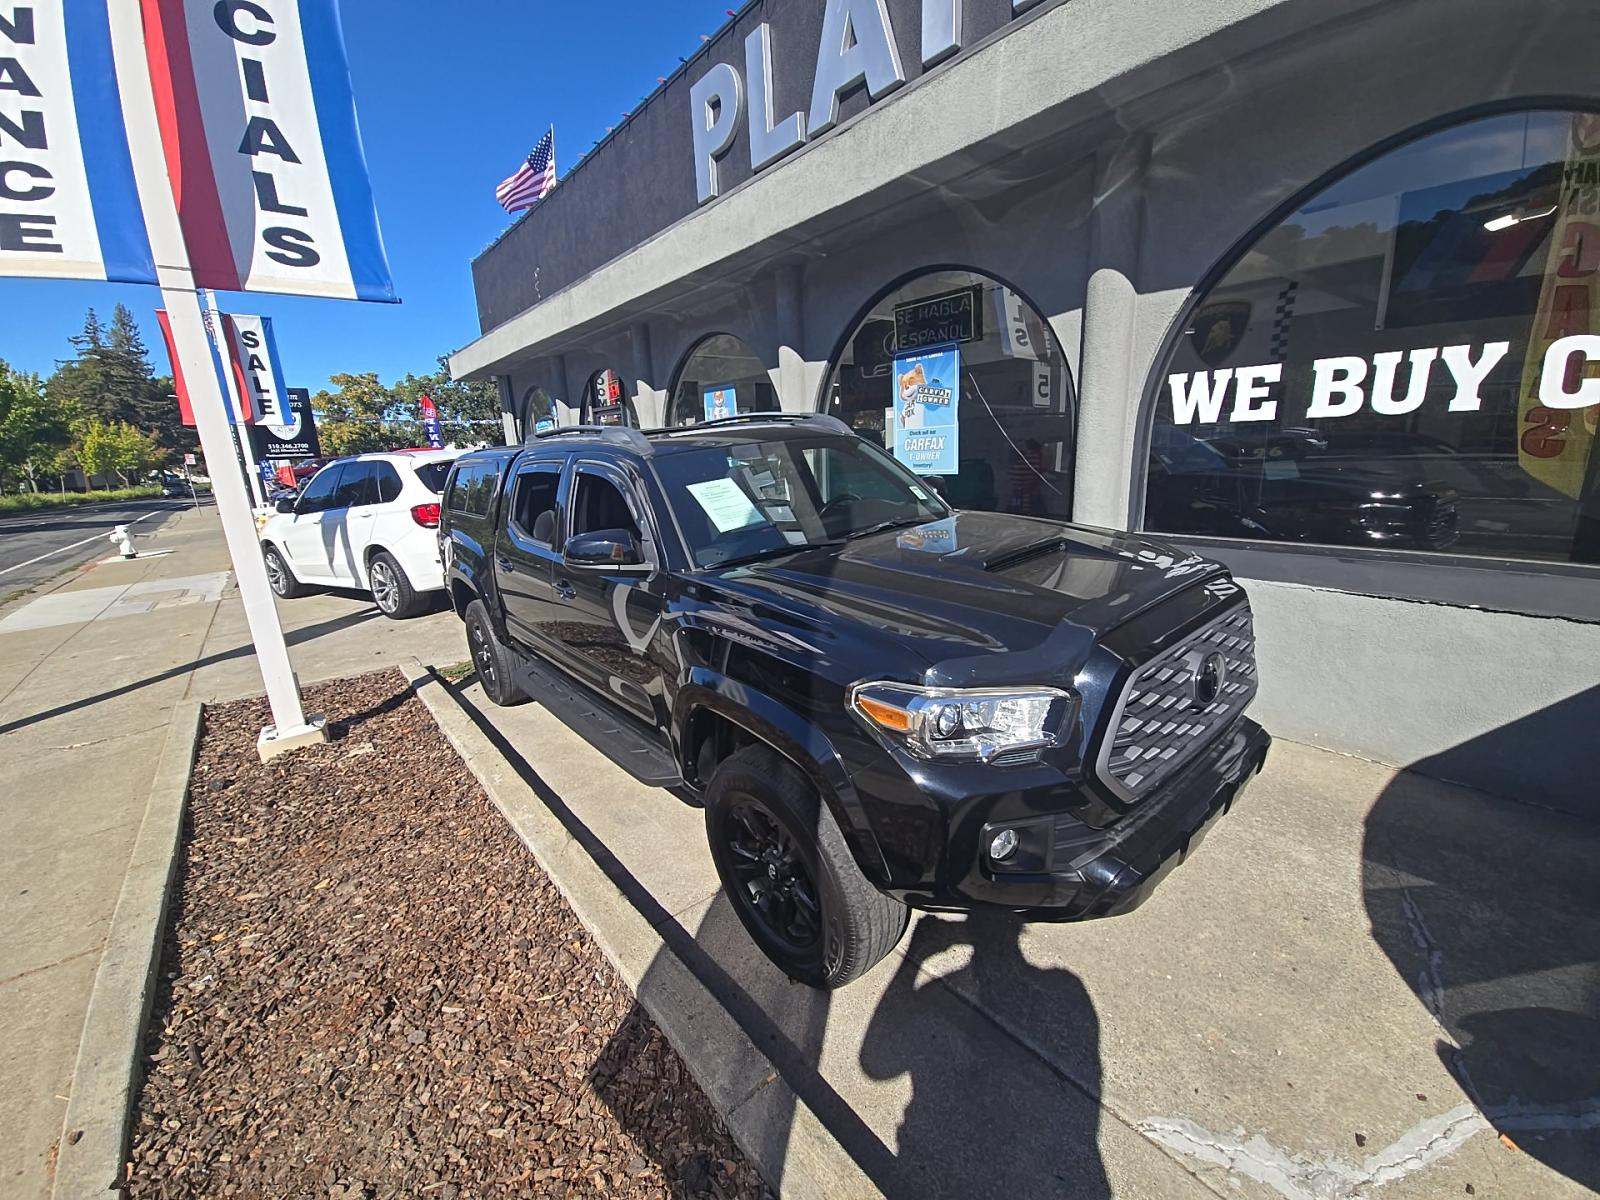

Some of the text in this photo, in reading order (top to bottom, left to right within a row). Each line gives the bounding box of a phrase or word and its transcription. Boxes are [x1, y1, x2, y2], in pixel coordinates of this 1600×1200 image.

[214, 0, 320, 267] CIALS
[919, 298, 971, 320] HABLA
[241, 330, 275, 415] SALE
[1168, 363, 1283, 425] WE
[1306, 342, 1510, 419] BUY
[904, 437, 945, 451] CARFAX
